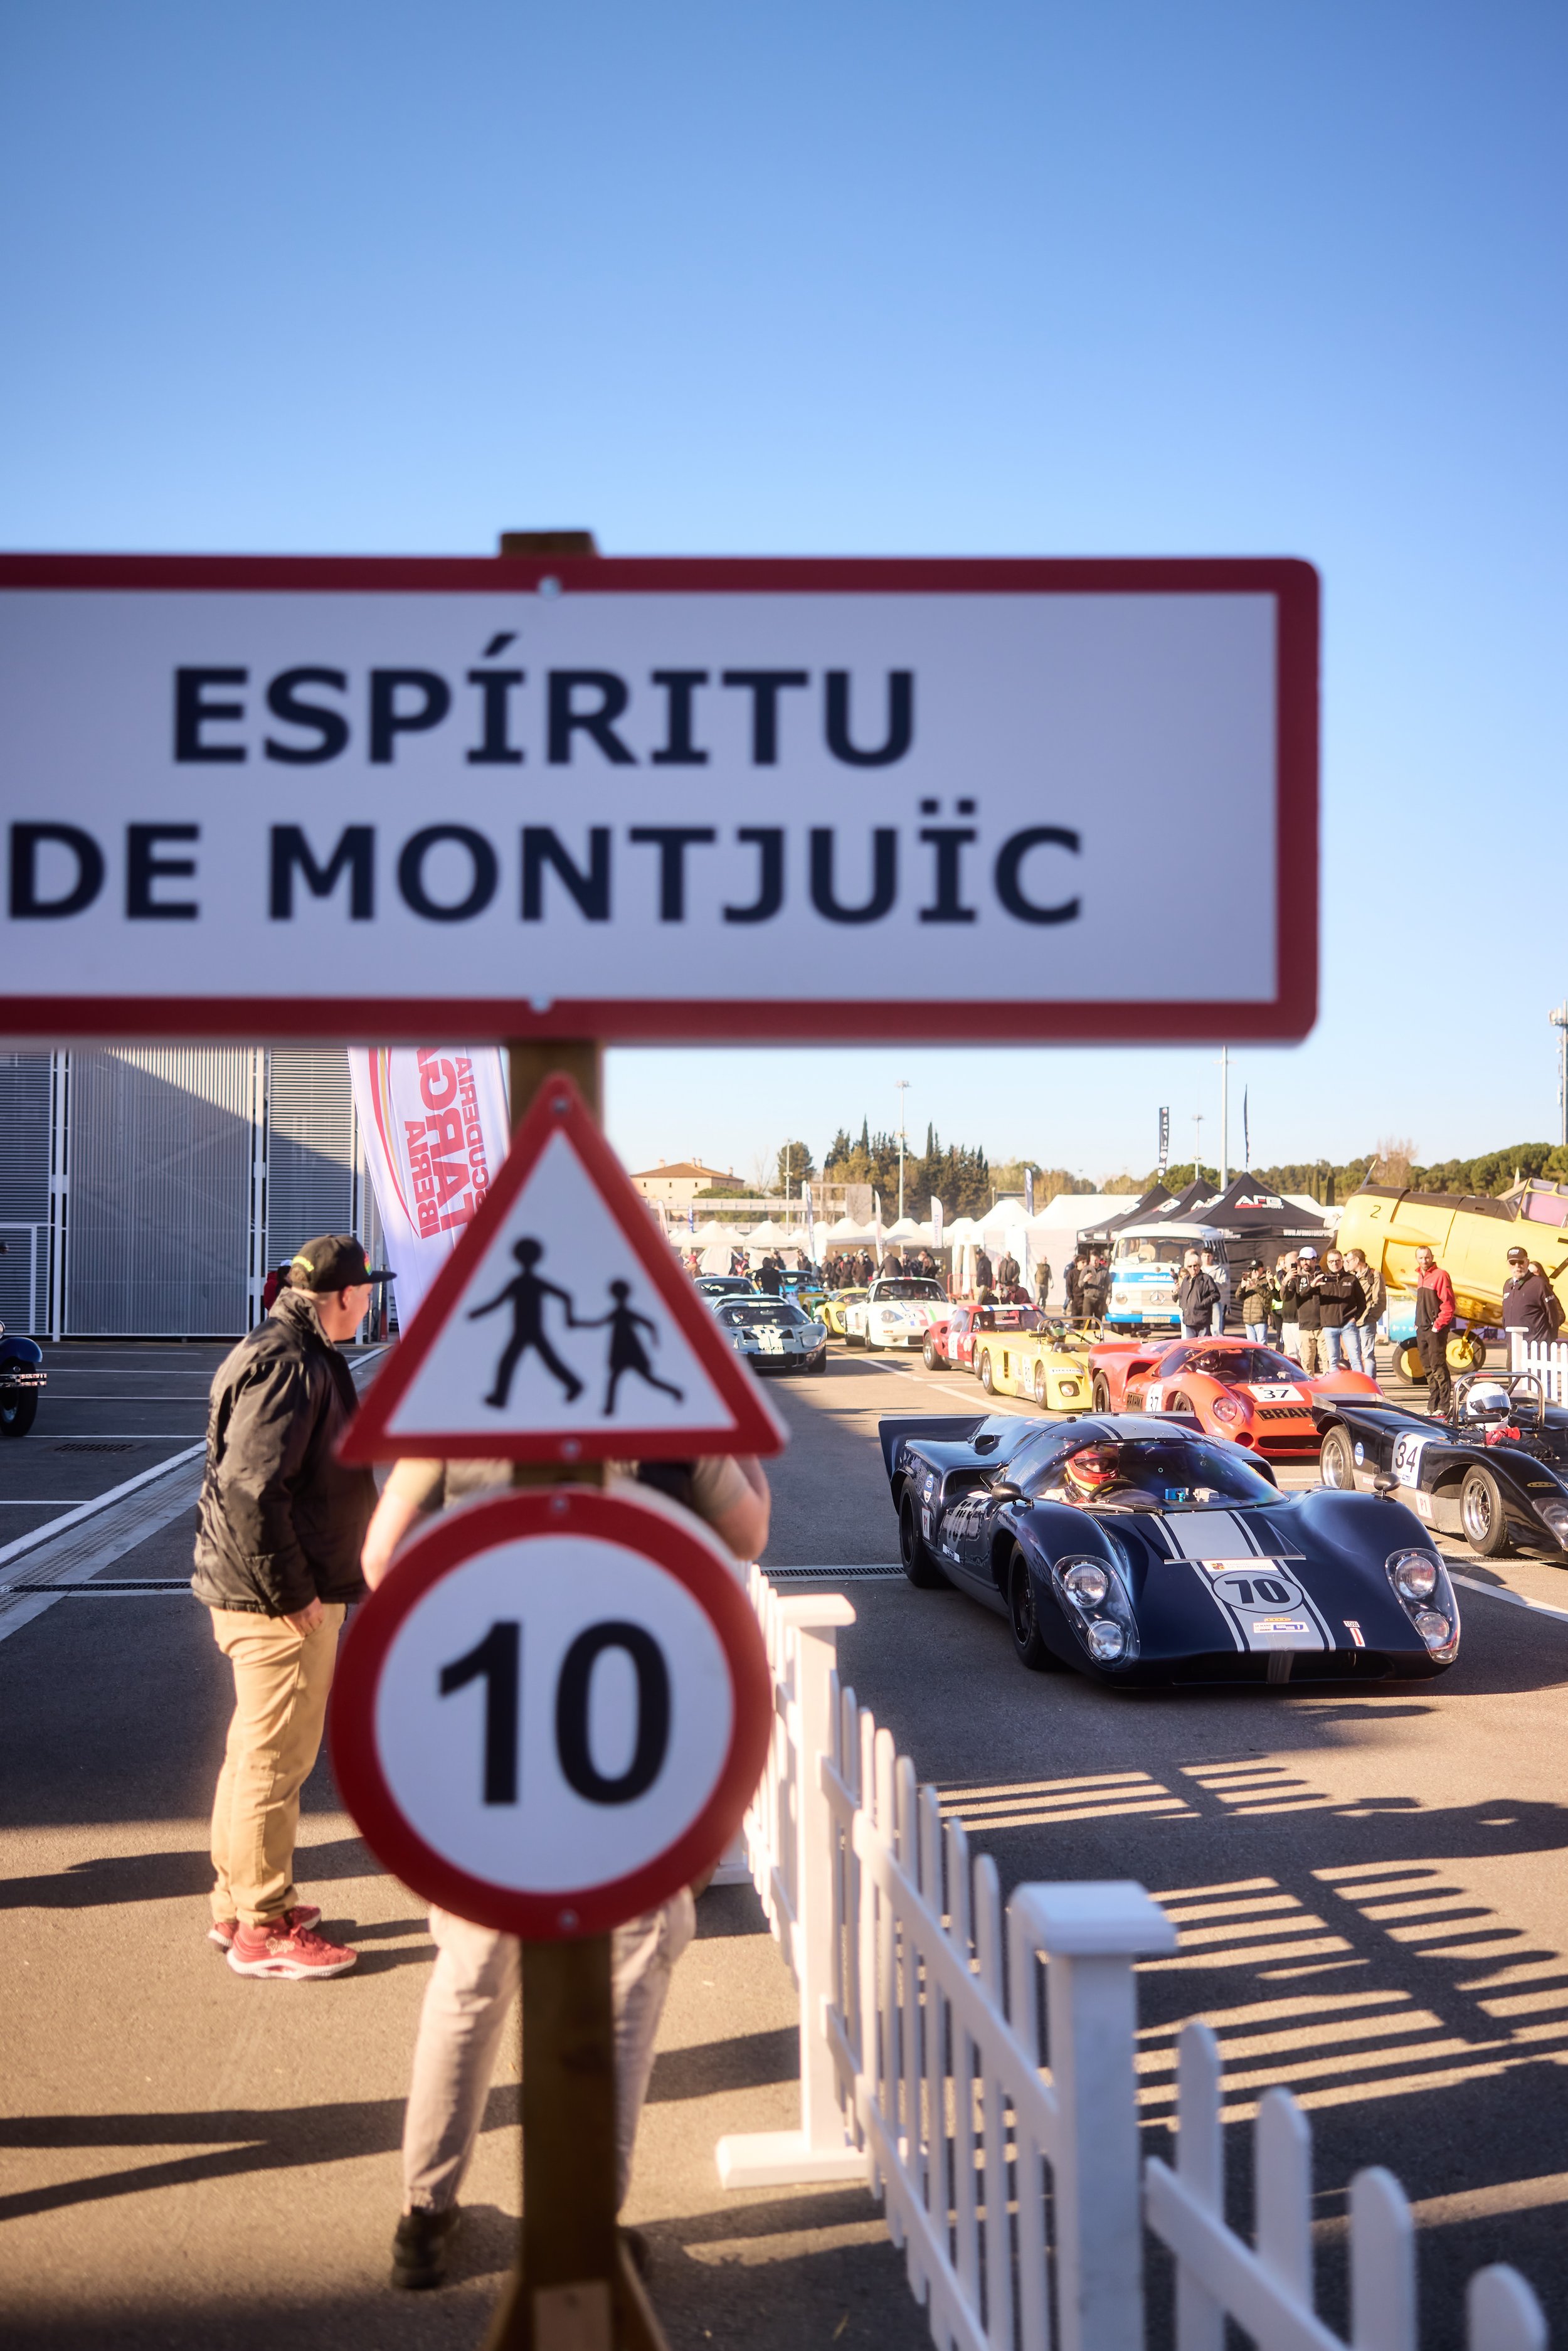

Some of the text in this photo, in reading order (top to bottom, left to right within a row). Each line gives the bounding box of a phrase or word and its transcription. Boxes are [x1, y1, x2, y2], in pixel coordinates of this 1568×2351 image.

[174, 632, 914, 769] ESPÍRITU
[8, 798, 1081, 925] DE MONTJUÏC
[1235, 1194, 1282, 1206] AFB
[1370, 1205, 1381, 1218] 2
[1263, 1389, 1289, 1399] 37
[1150, 1396, 1159, 1412] 37
[1258, 1407, 1312, 1420] BRAH
[1396, 1441, 1417, 1473] 34
[1419, 1498, 1428, 1512] P1
[1224, 1578, 1291, 1604] 70
[438, 1618, 671, 1807] 10
